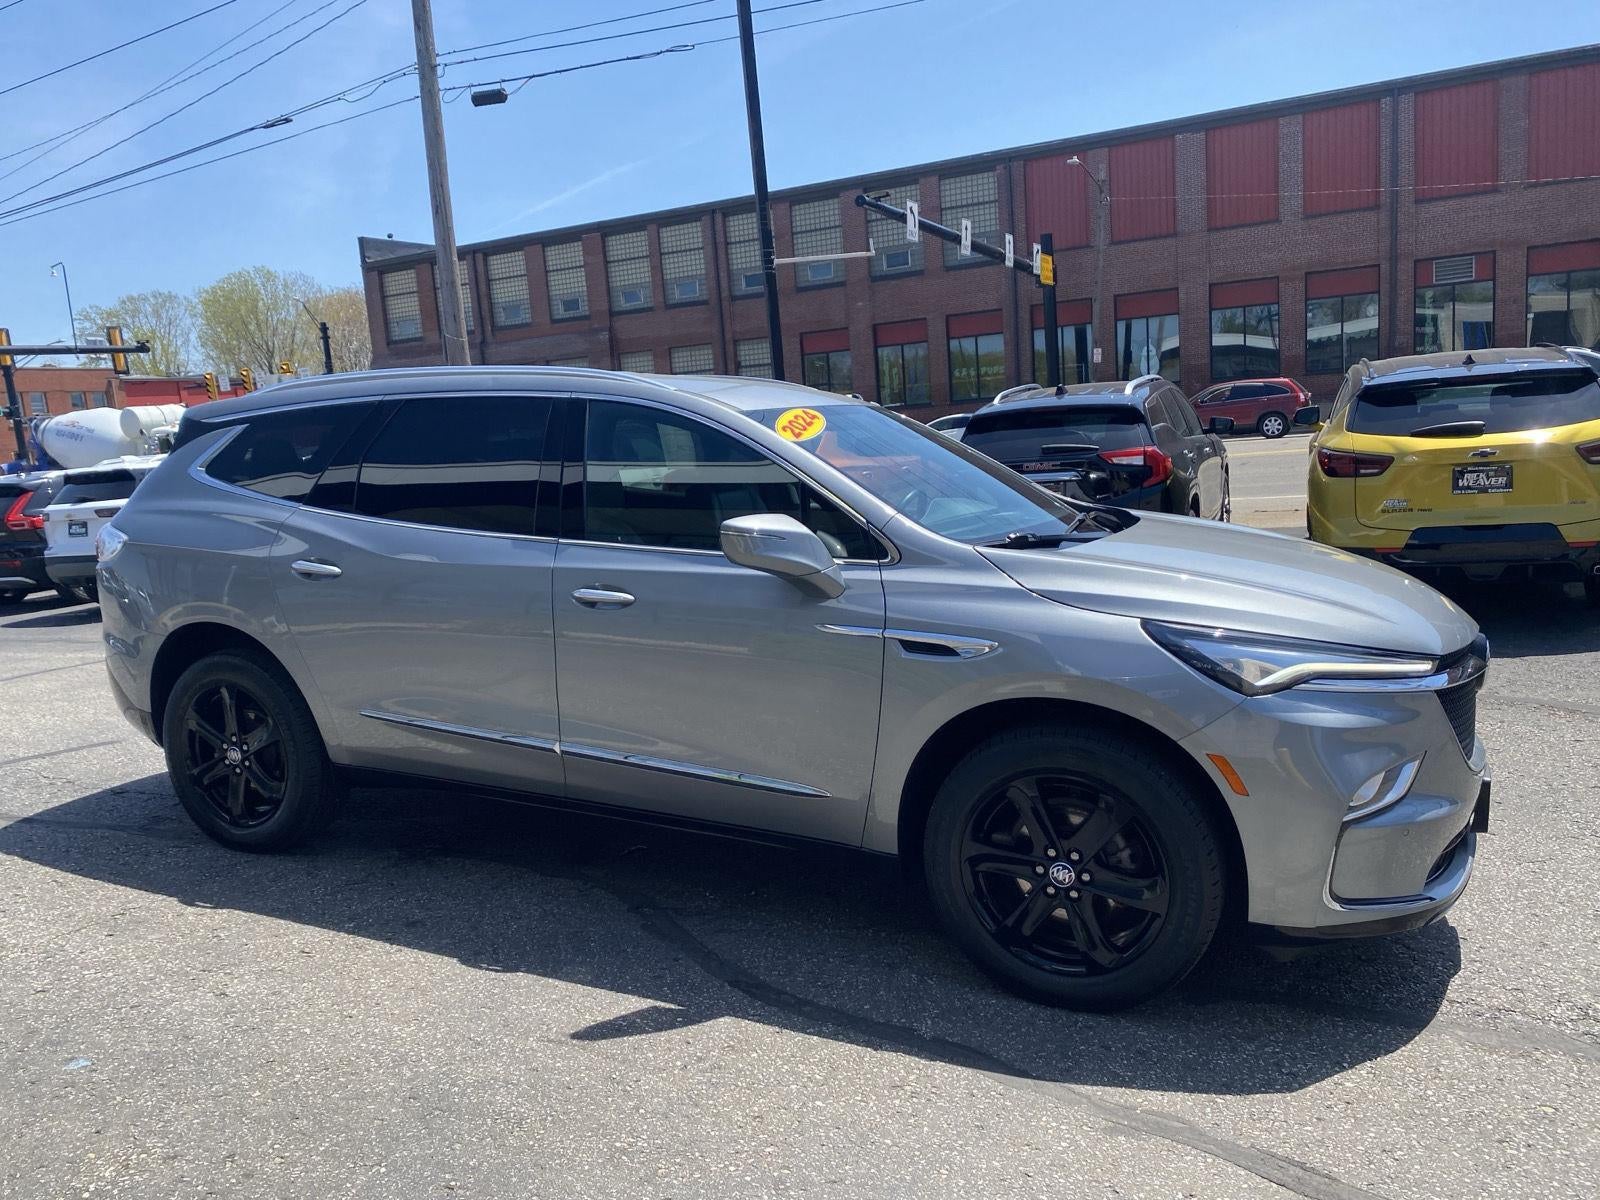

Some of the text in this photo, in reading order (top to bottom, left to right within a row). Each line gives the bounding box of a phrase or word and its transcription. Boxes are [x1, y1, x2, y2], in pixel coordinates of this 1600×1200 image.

[782, 409, 819, 438] 2024
[1459, 476, 1507, 487] WEAVER
[1464, 472, 1486, 480] RICK
